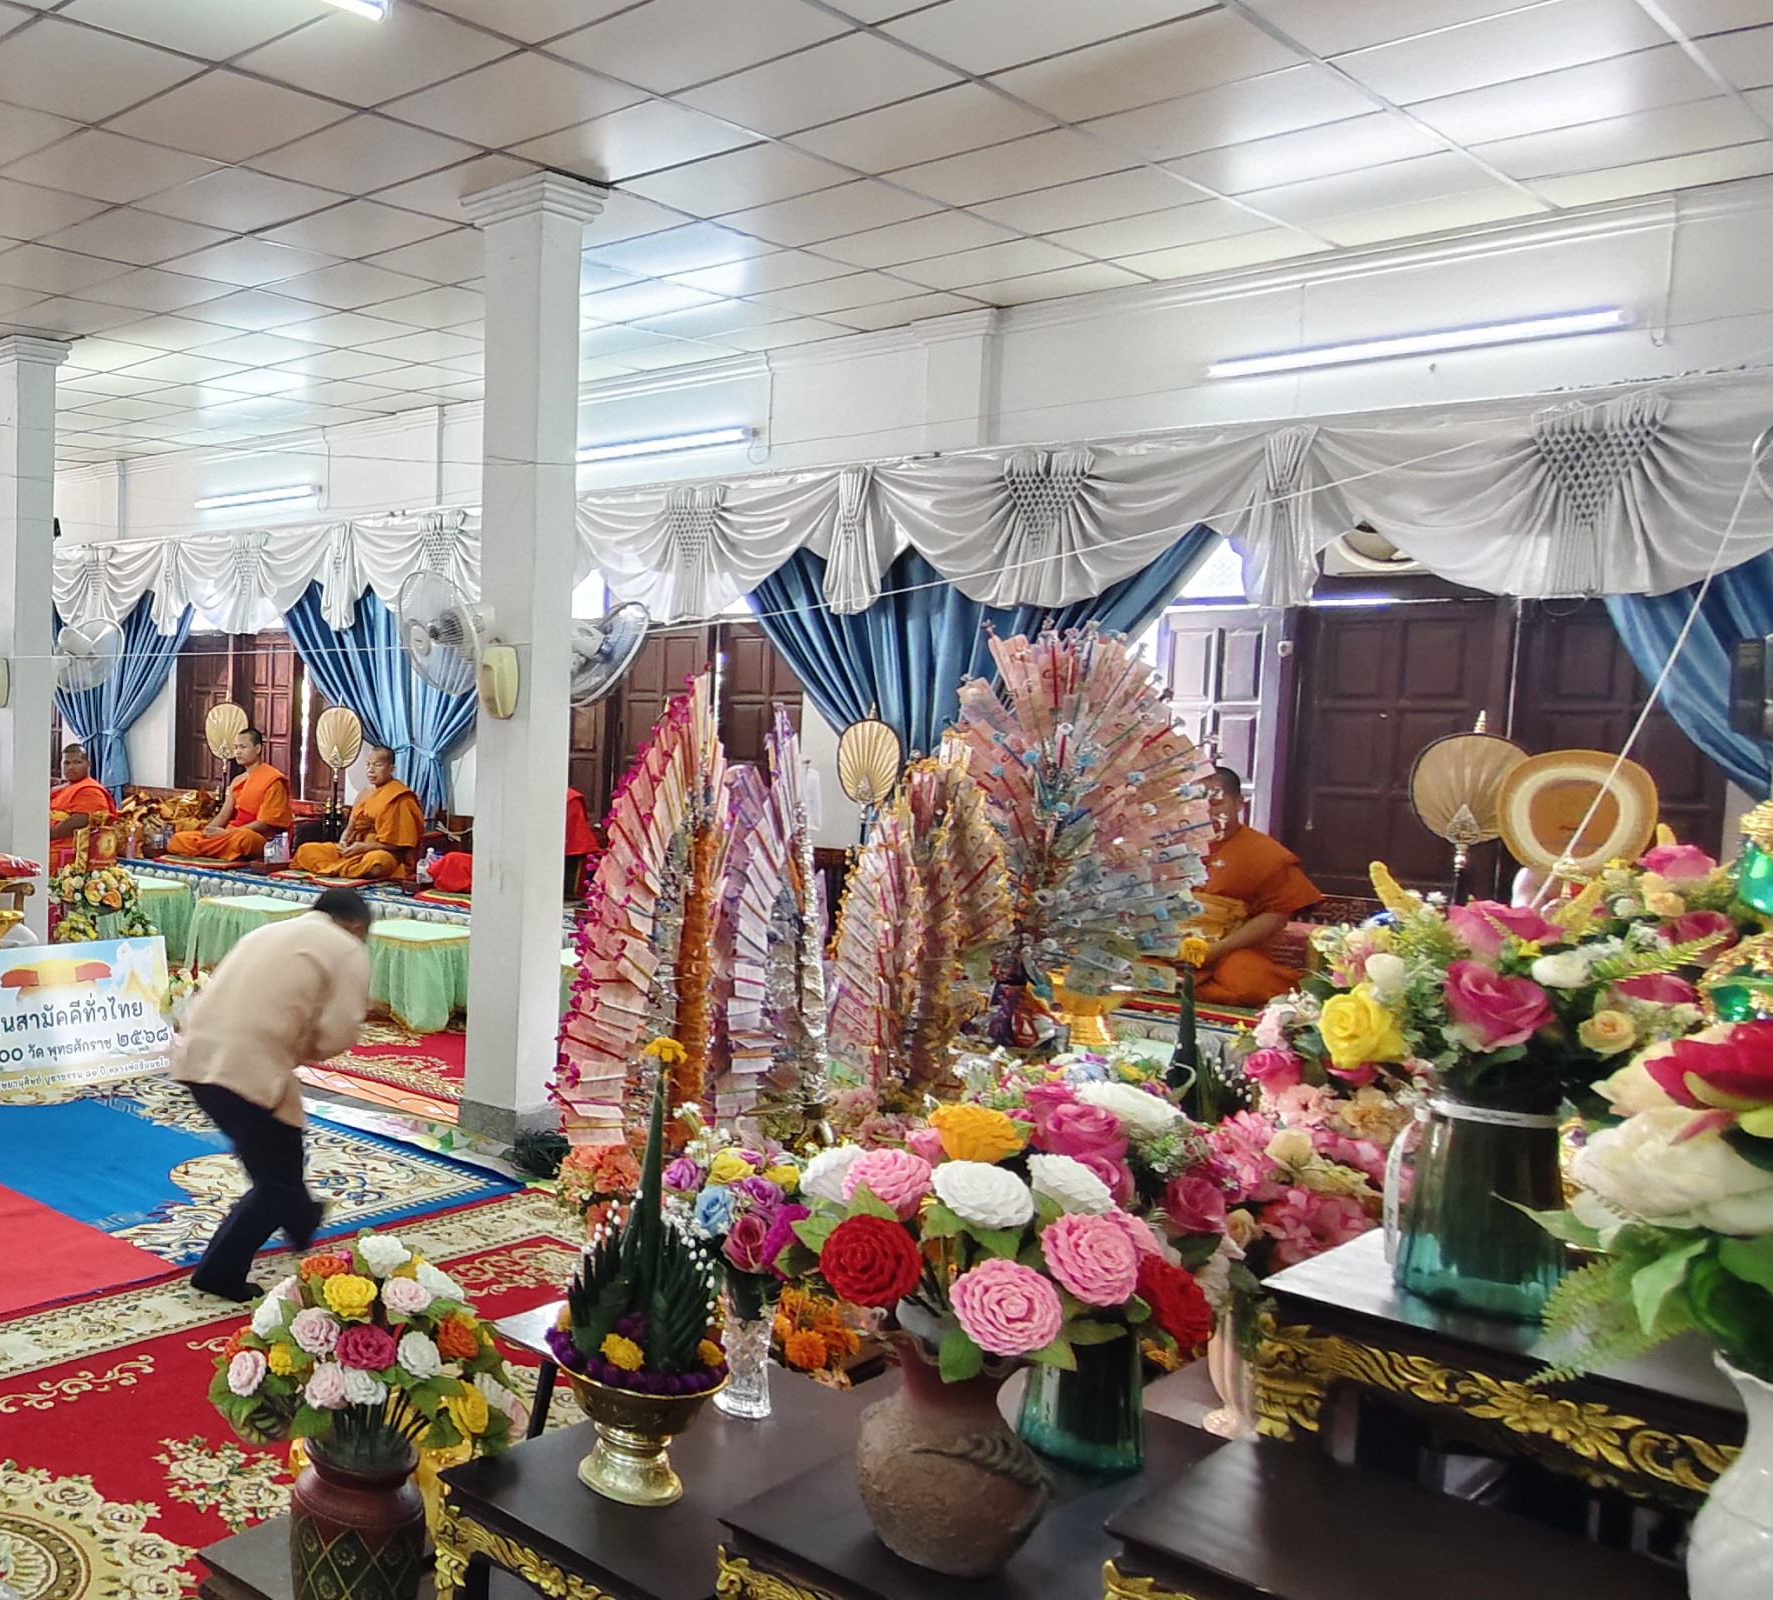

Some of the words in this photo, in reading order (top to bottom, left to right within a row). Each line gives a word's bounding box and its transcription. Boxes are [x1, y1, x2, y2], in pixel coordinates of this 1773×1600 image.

[28, 1043, 45, 1060] วัด
[48, 1038, 112, 1061] พุทธศักราช
[116, 1027, 169, 1048] ๒๕๖๘
